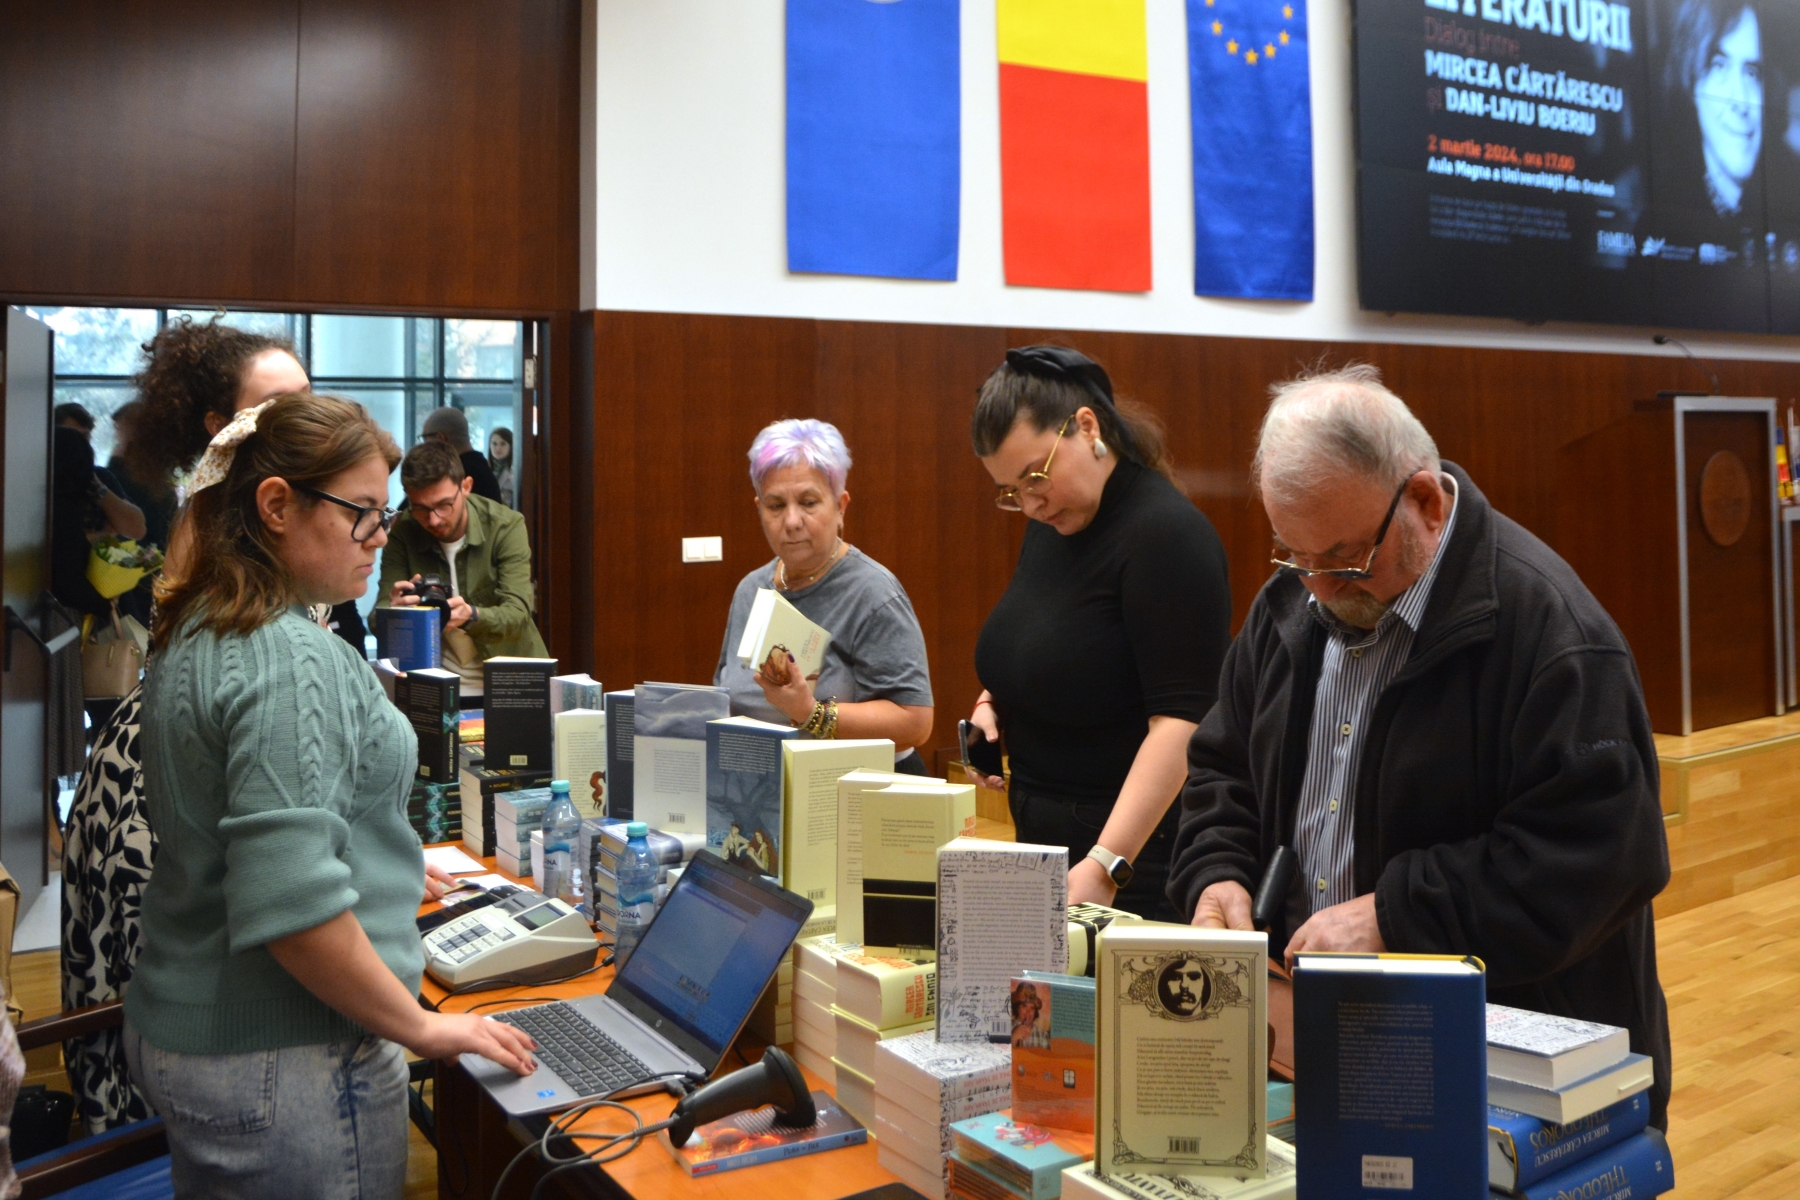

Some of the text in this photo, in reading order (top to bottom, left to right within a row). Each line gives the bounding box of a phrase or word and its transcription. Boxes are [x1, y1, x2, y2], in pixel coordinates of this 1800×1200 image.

[1424, 0, 1633, 52] ERATURII
[1424, 16, 1475, 55] Dialog
[1424, 49, 1624, 112] MIRCEA CĂRTĂRESCU
[1444, 86, 1536, 126] DAN-LIVIU
[1537, 104, 1597, 137] BOERIU
[1427, 134, 1437, 152] 2
[1440, 137, 1482, 159] martie
[1483, 143, 1522, 165] 2024,
[1523, 151, 1543, 169] ora
[1427, 156, 1453, 175] Aula
[1455, 160, 1492, 182] Magna
[1492, 168, 1501, 178] a
[1565, 175, 1581, 192] din
[1582, 1123, 1610, 1144] MIRCEA
[1547, 1166, 1629, 1200] THEODOR
[1602, 1186, 1632, 1200] MIRCE
